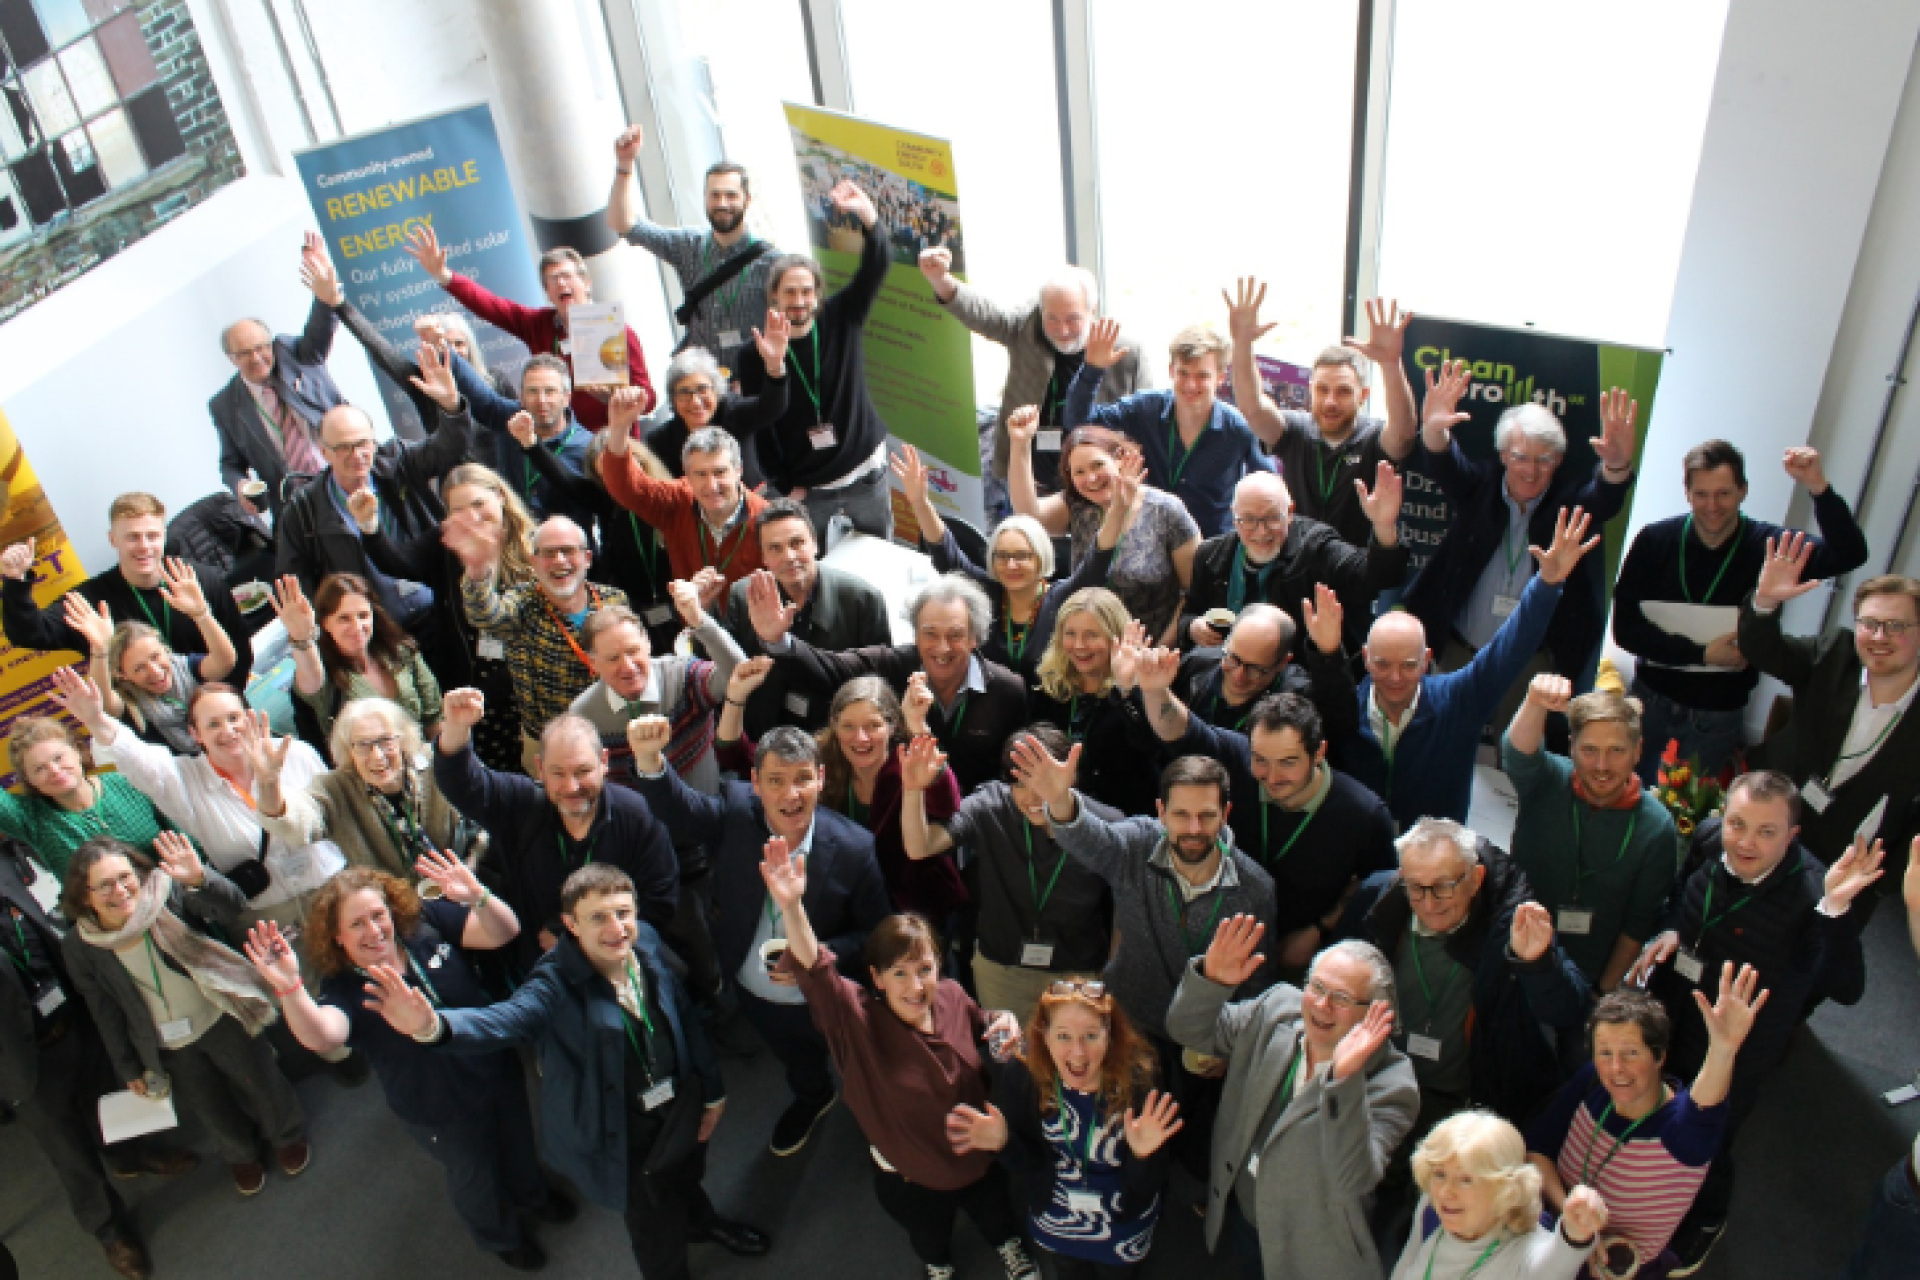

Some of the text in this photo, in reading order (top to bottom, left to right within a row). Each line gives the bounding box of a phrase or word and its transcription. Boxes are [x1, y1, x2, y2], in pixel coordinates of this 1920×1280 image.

[327, 161, 479, 220] RENEWABLE
[351, 267, 379, 284] Our
[475, 230, 510, 250] solar
